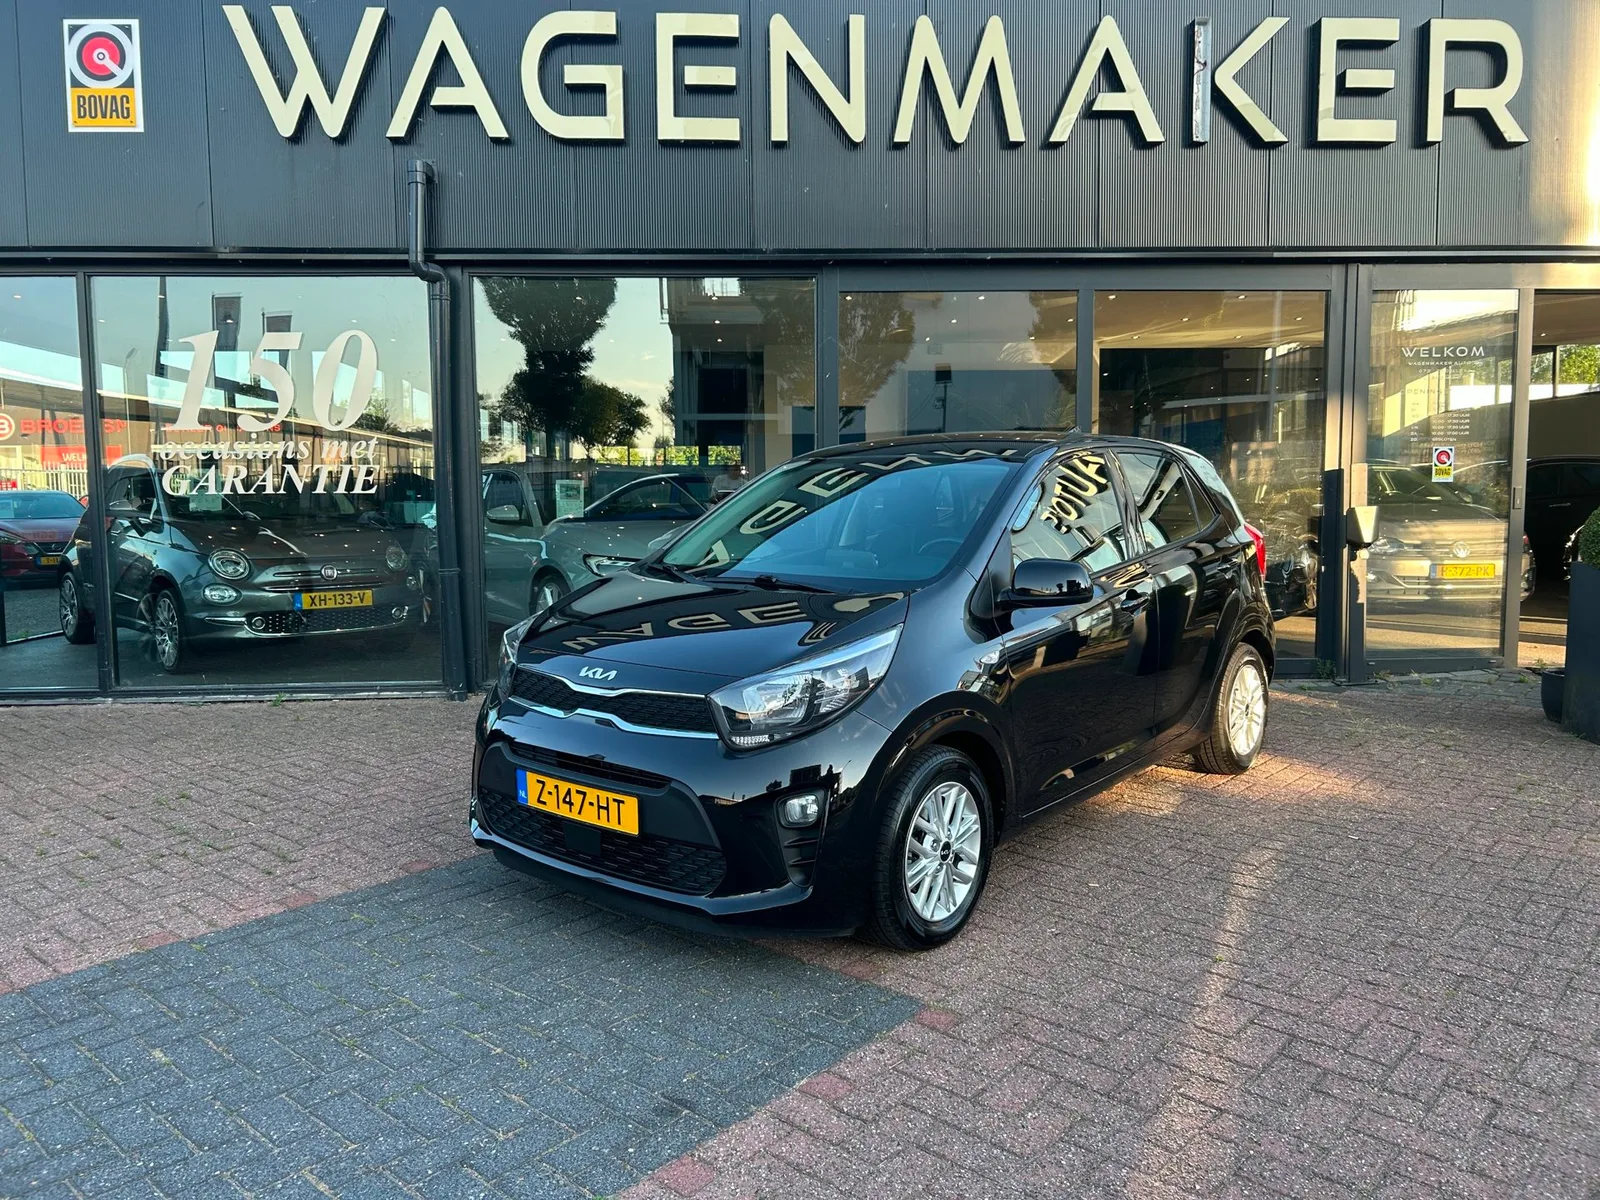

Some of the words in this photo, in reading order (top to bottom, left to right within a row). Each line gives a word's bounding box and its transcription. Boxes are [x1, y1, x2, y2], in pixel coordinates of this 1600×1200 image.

[222, 5, 1529, 144] WAGENMAKER
[76, 94, 131, 120] BOVAG
[1401, 346, 1485, 358] WELKOM
[161, 329, 379, 432] 150
[160, 432, 313, 461] occasions
[321, 437, 379, 461] met
[162, 464, 381, 496] GARANTIE
[1434, 467, 1451, 476] BOVAG
[308, 591, 367, 608] XH-133-V
[578, 665, 618, 681] KIA
[519, 789, 528, 799] NL
[535, 778, 626, 827] Z-147-HT
